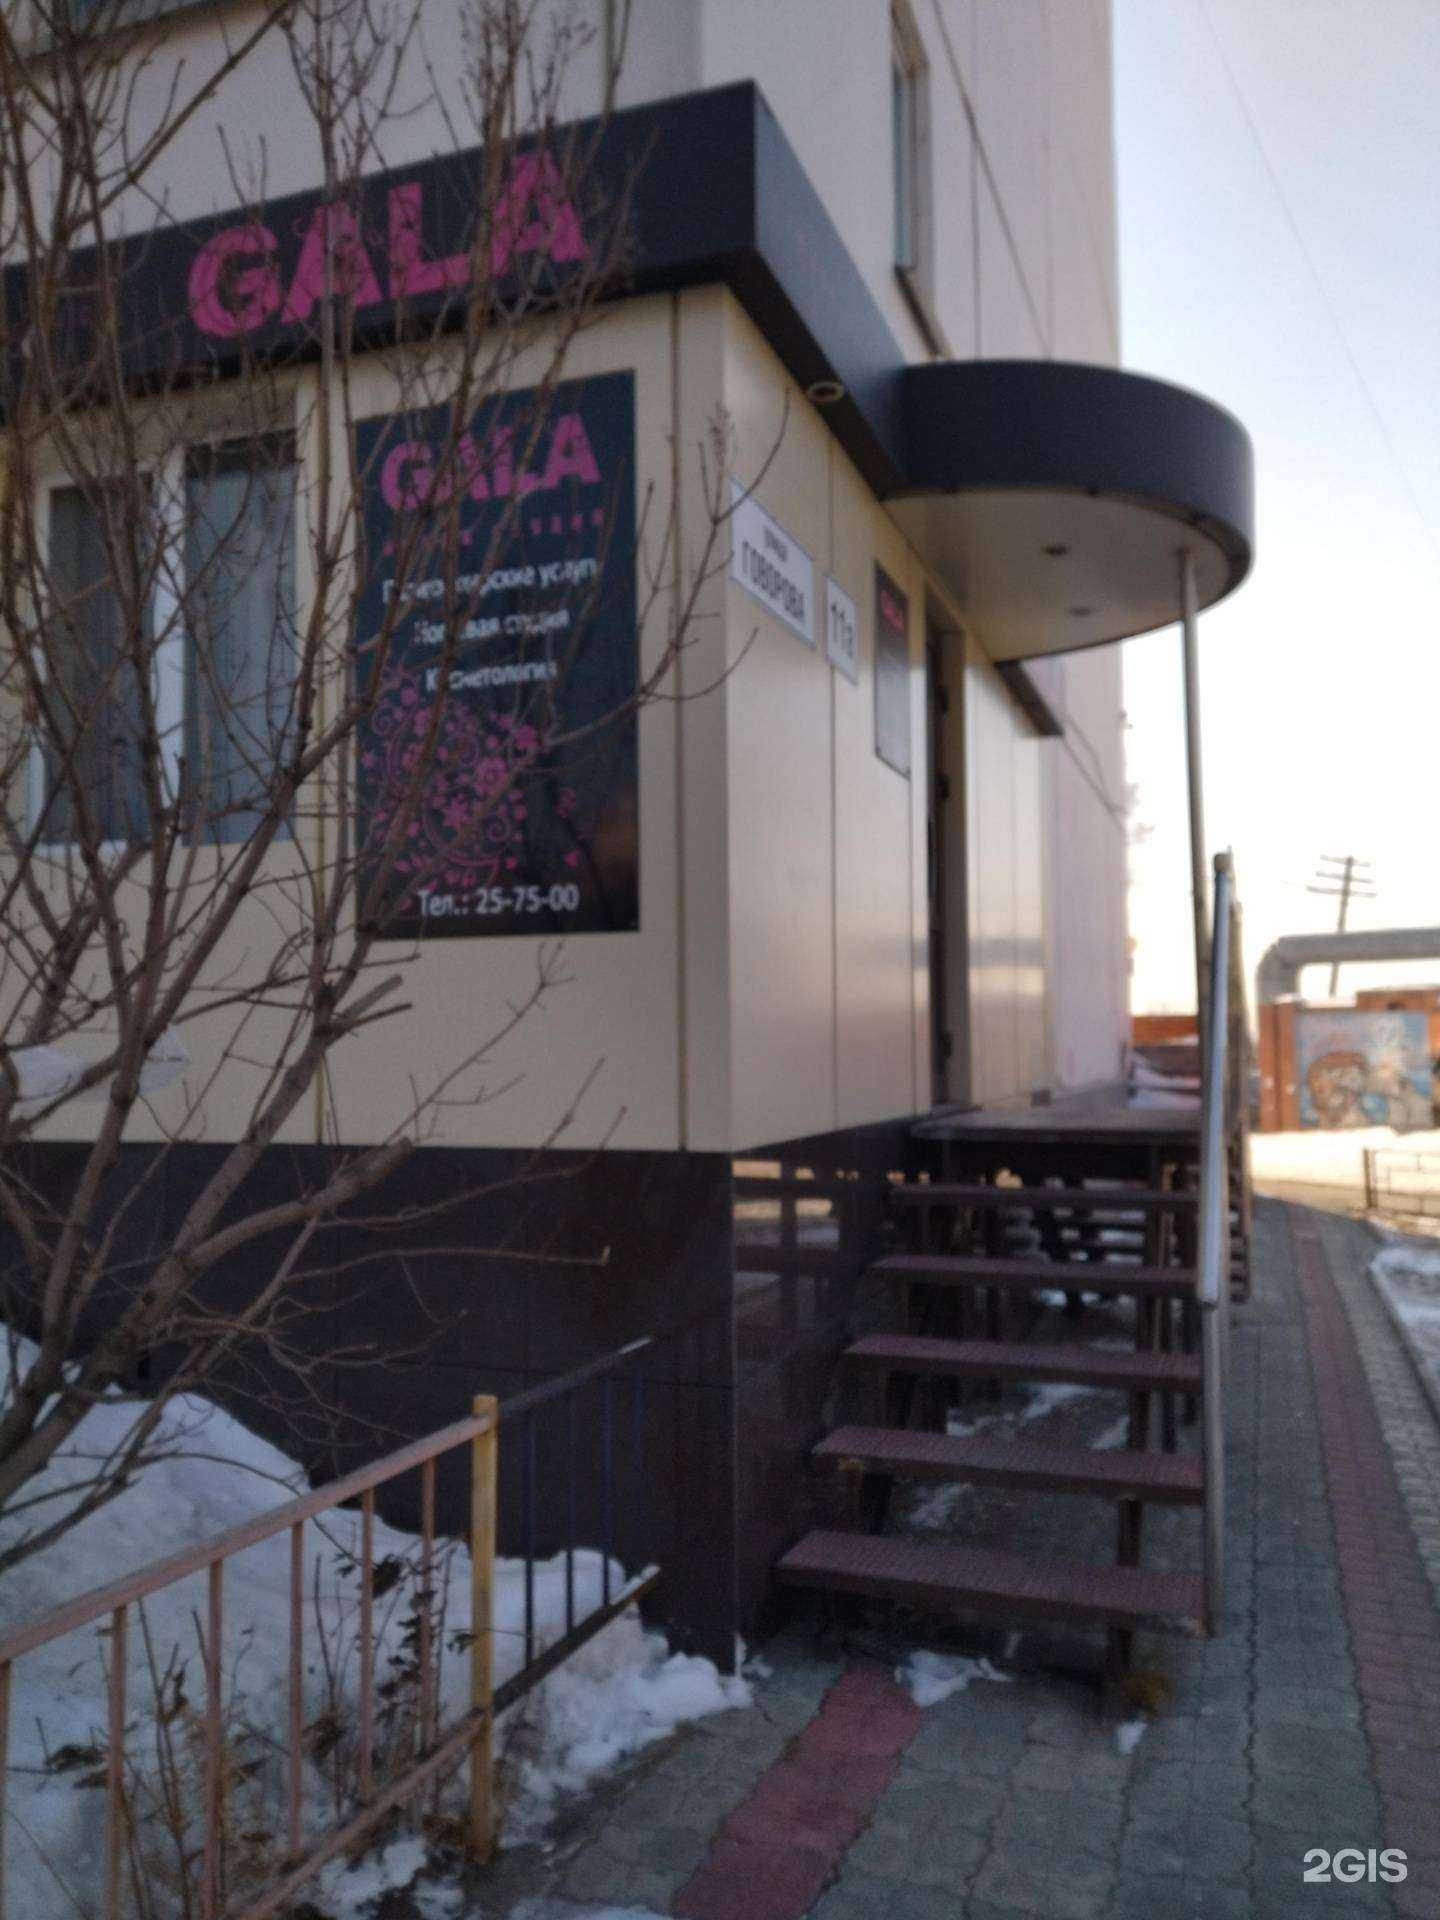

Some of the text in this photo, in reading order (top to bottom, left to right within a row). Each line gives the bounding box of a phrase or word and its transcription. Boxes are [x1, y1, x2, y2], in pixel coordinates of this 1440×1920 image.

[187, 150, 590, 338] GALA
[380, 411, 602, 510] GALA
[382, 565, 536, 604] Прикарские
[414, 616, 501, 645] Ногвая
[425, 661, 558, 692] Ксметология
[476, 883, 580, 914] 25-75-00
